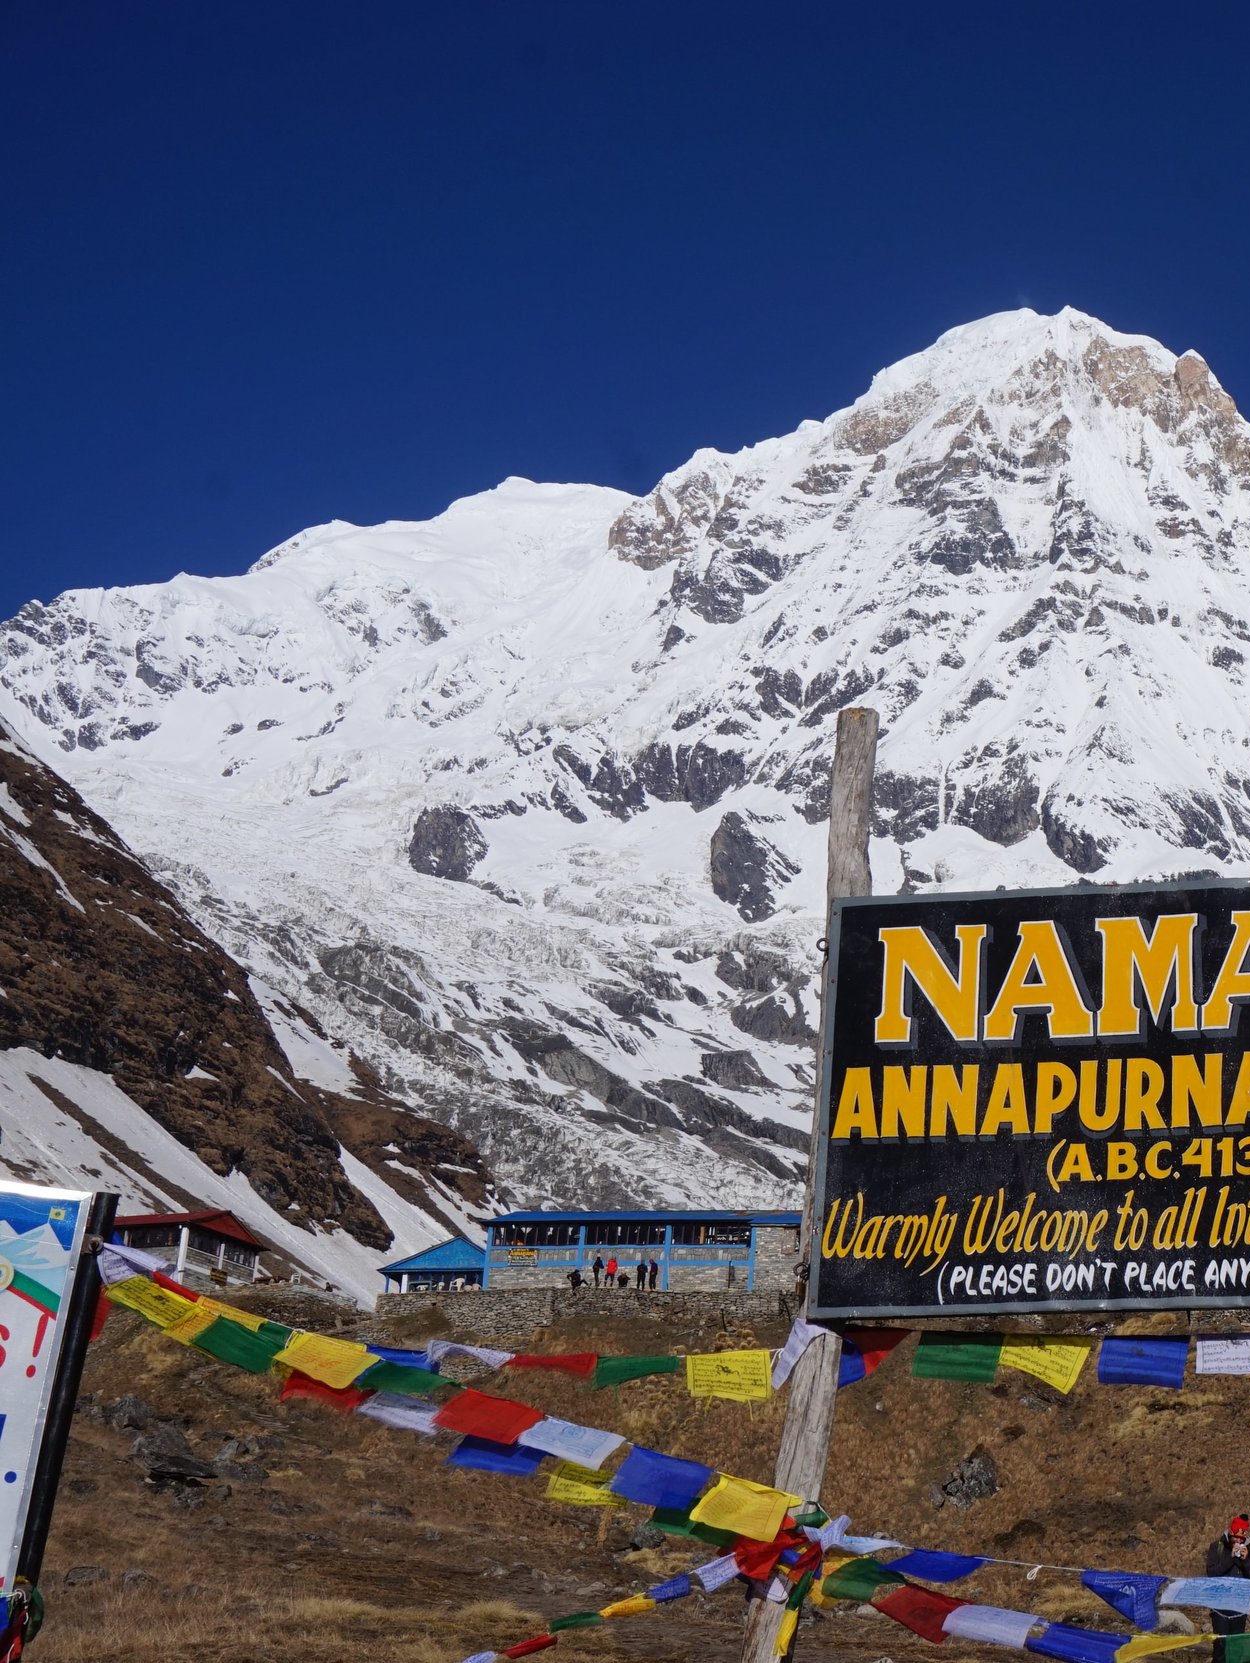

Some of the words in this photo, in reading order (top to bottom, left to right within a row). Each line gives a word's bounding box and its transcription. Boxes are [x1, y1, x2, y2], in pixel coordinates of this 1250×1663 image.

[821, 1192, 959, 1277] Warmly
[963, 1187, 1109, 1260] Welcome
[1113, 1190, 1150, 1251] to
[1152, 1185, 1208, 1250] all
[937, 1261, 1038, 1305] (PLEASE
[1045, 1259, 1118, 1293] DON'T
[1123, 1259, 1197, 1292] PLACE
